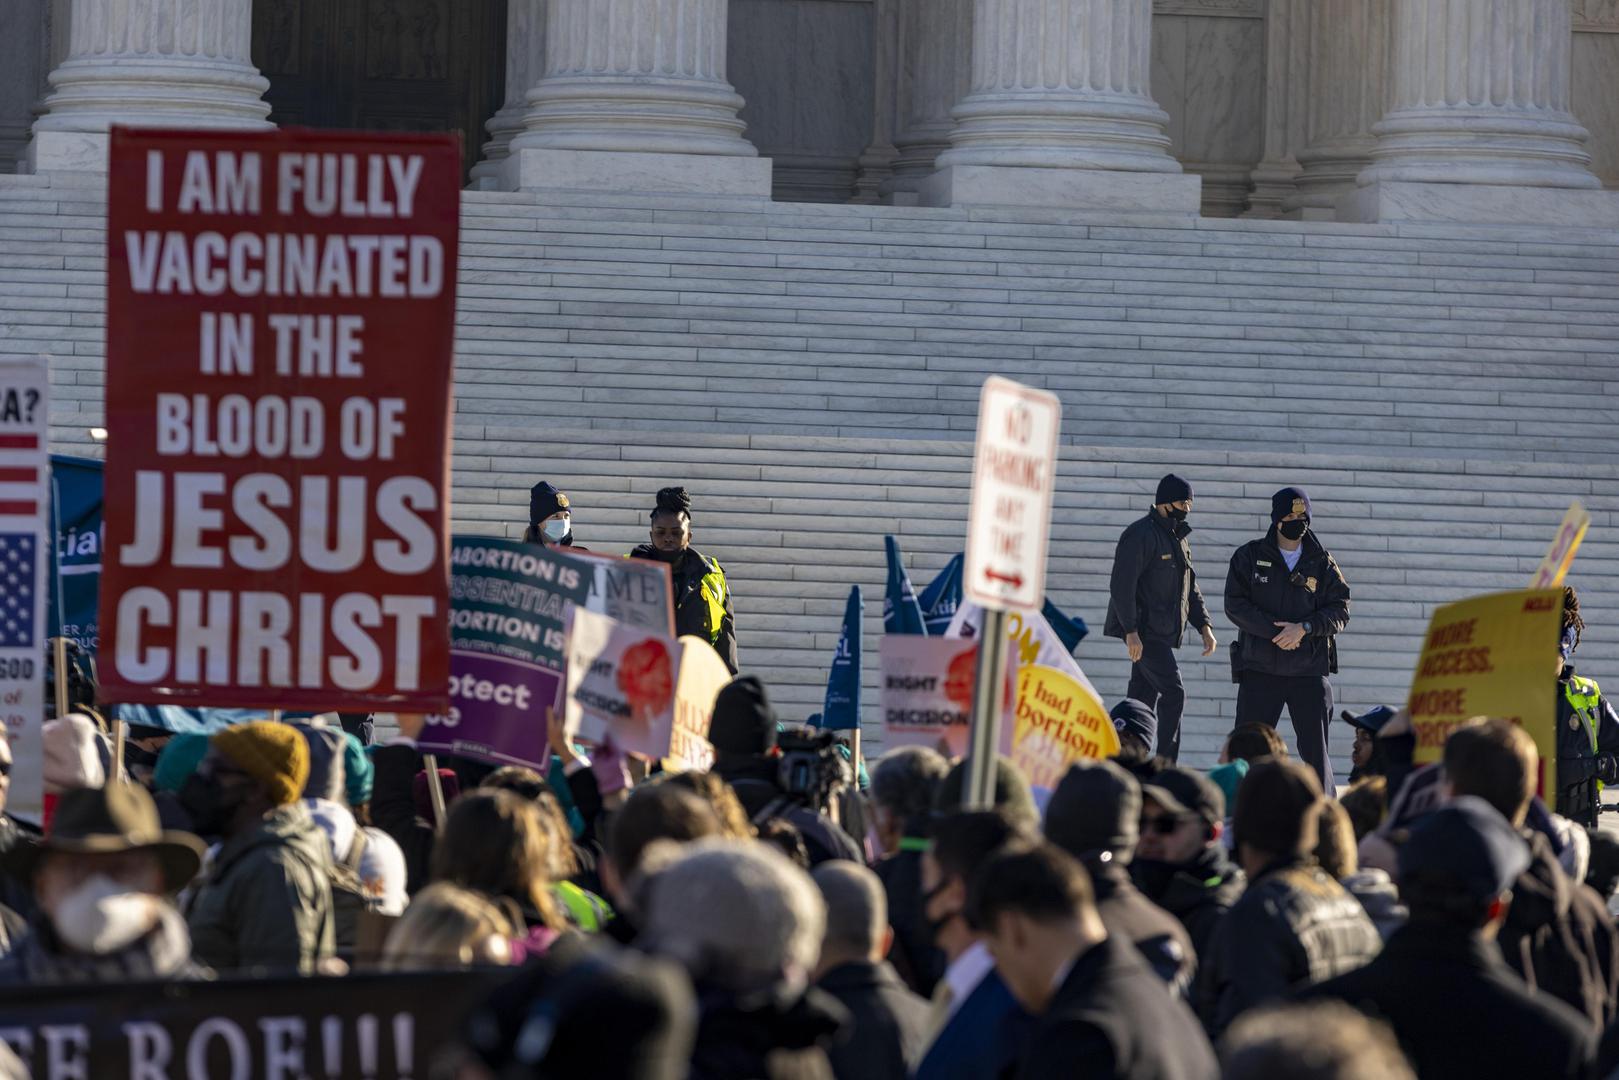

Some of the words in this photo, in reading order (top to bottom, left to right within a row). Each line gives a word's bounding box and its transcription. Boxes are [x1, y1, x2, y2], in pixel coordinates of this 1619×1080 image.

[147, 149, 163, 213] I
[178, 151, 261, 215] AM
[278, 152, 424, 218] FULLY
[125, 230, 444, 298] VACCINATED
[200, 312, 254, 375] IN
[269, 314, 364, 378] THE
[0, 386, 40, 422] A?
[157, 392, 325, 459] BLOOD
[341, 397, 406, 460] OF
[119, 469, 437, 575] JESUS
[558, 566, 580, 589] IS
[115, 586, 436, 691] CHRIST
[1430, 617, 1478, 650] MORE
[886, 675, 938, 692] RIGHT
[1034, 680, 1073, 715] had
[1075, 709, 1100, 733] an
